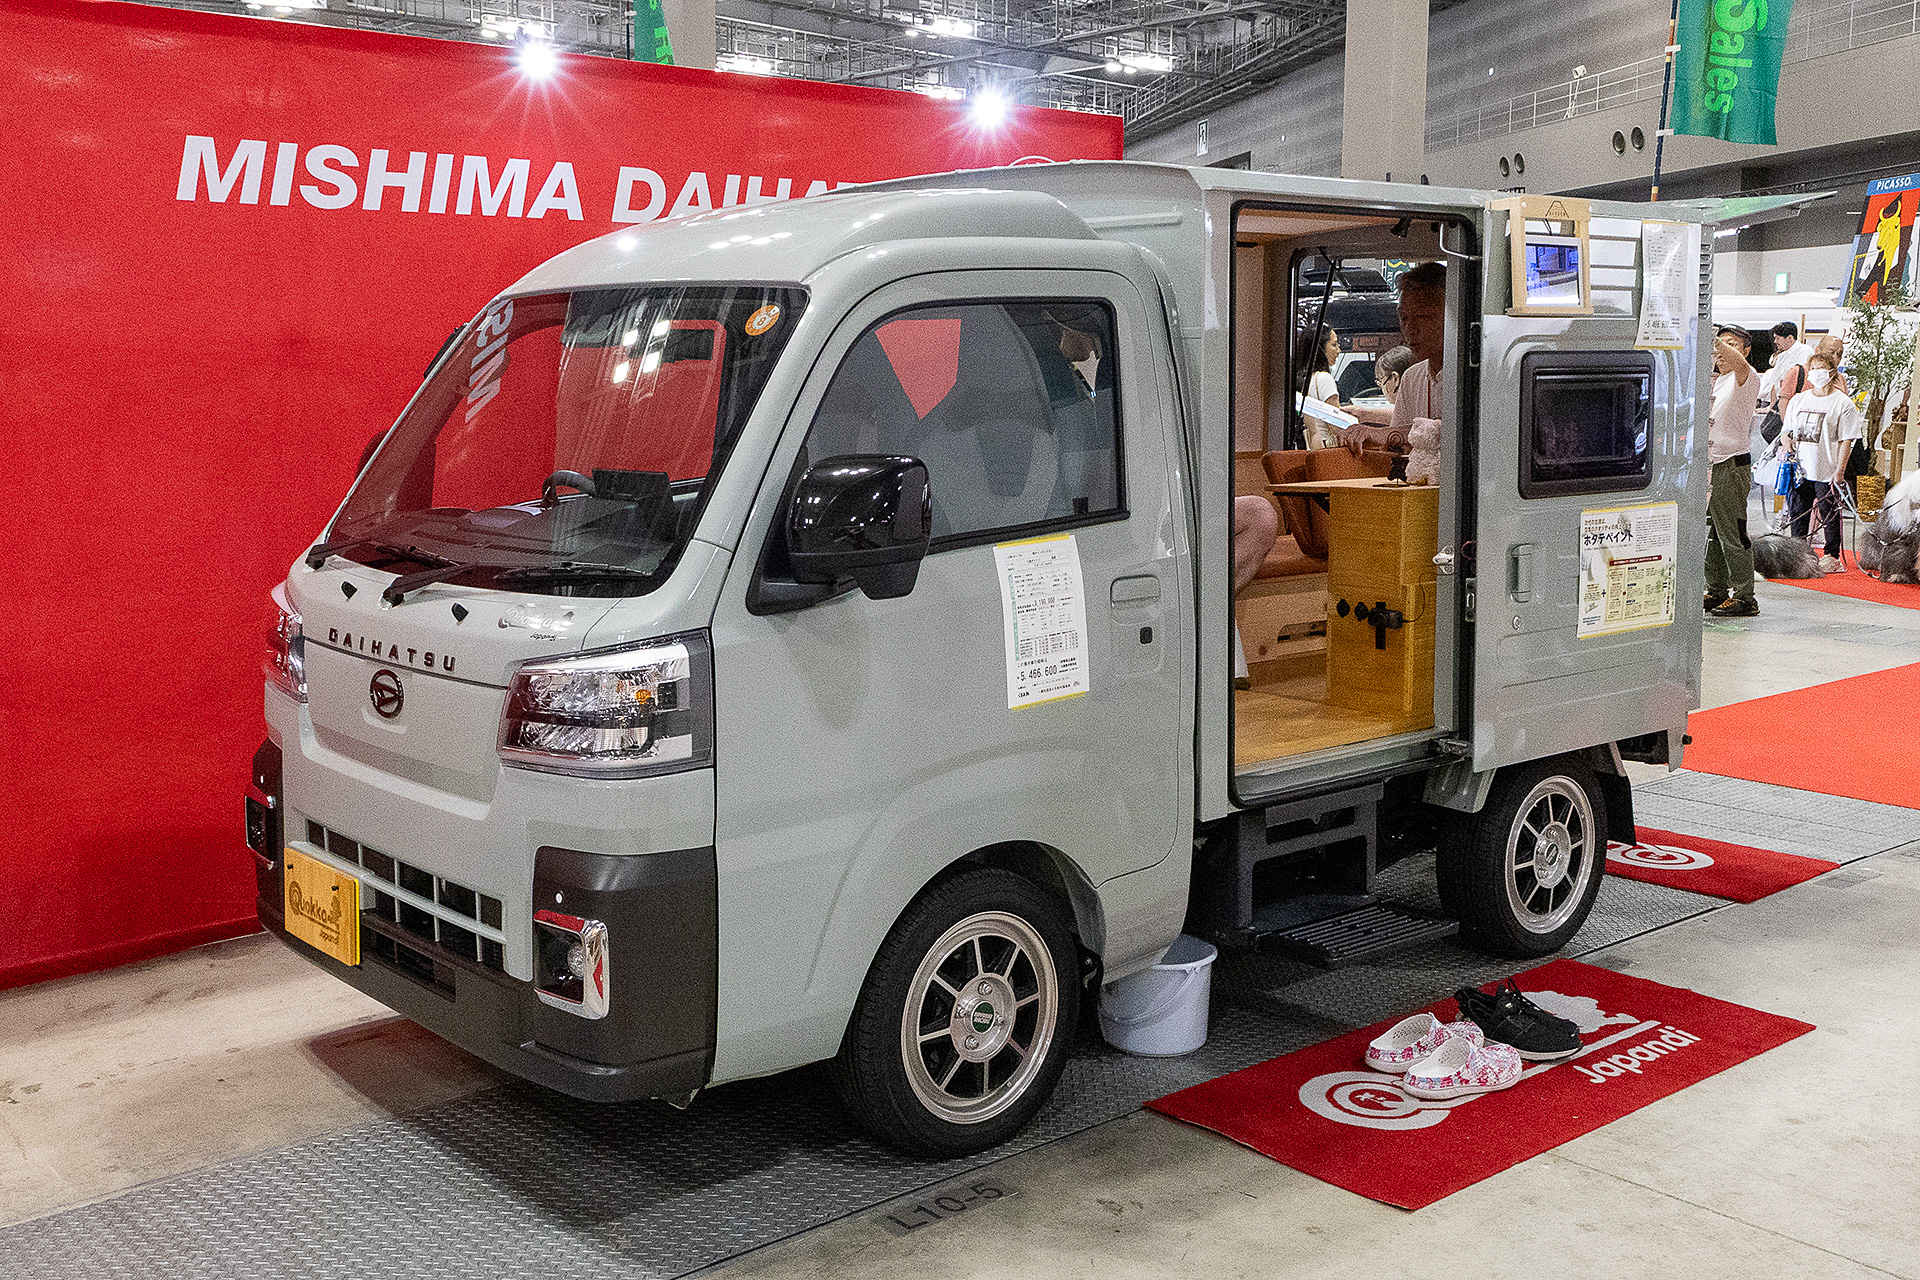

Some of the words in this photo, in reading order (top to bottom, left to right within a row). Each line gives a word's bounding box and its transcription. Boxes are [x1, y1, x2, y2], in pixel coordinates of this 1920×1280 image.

[1704, 0, 1768, 114] Sales
[175, 134, 584, 221] MISHIMA
[1584, 529, 1634, 546] ホタテペイント
[328, 627, 456, 672] DAIHATSU
[1572, 1025, 1702, 1084] Japandi
[886, 1181, 1004, 1231] L10-5
